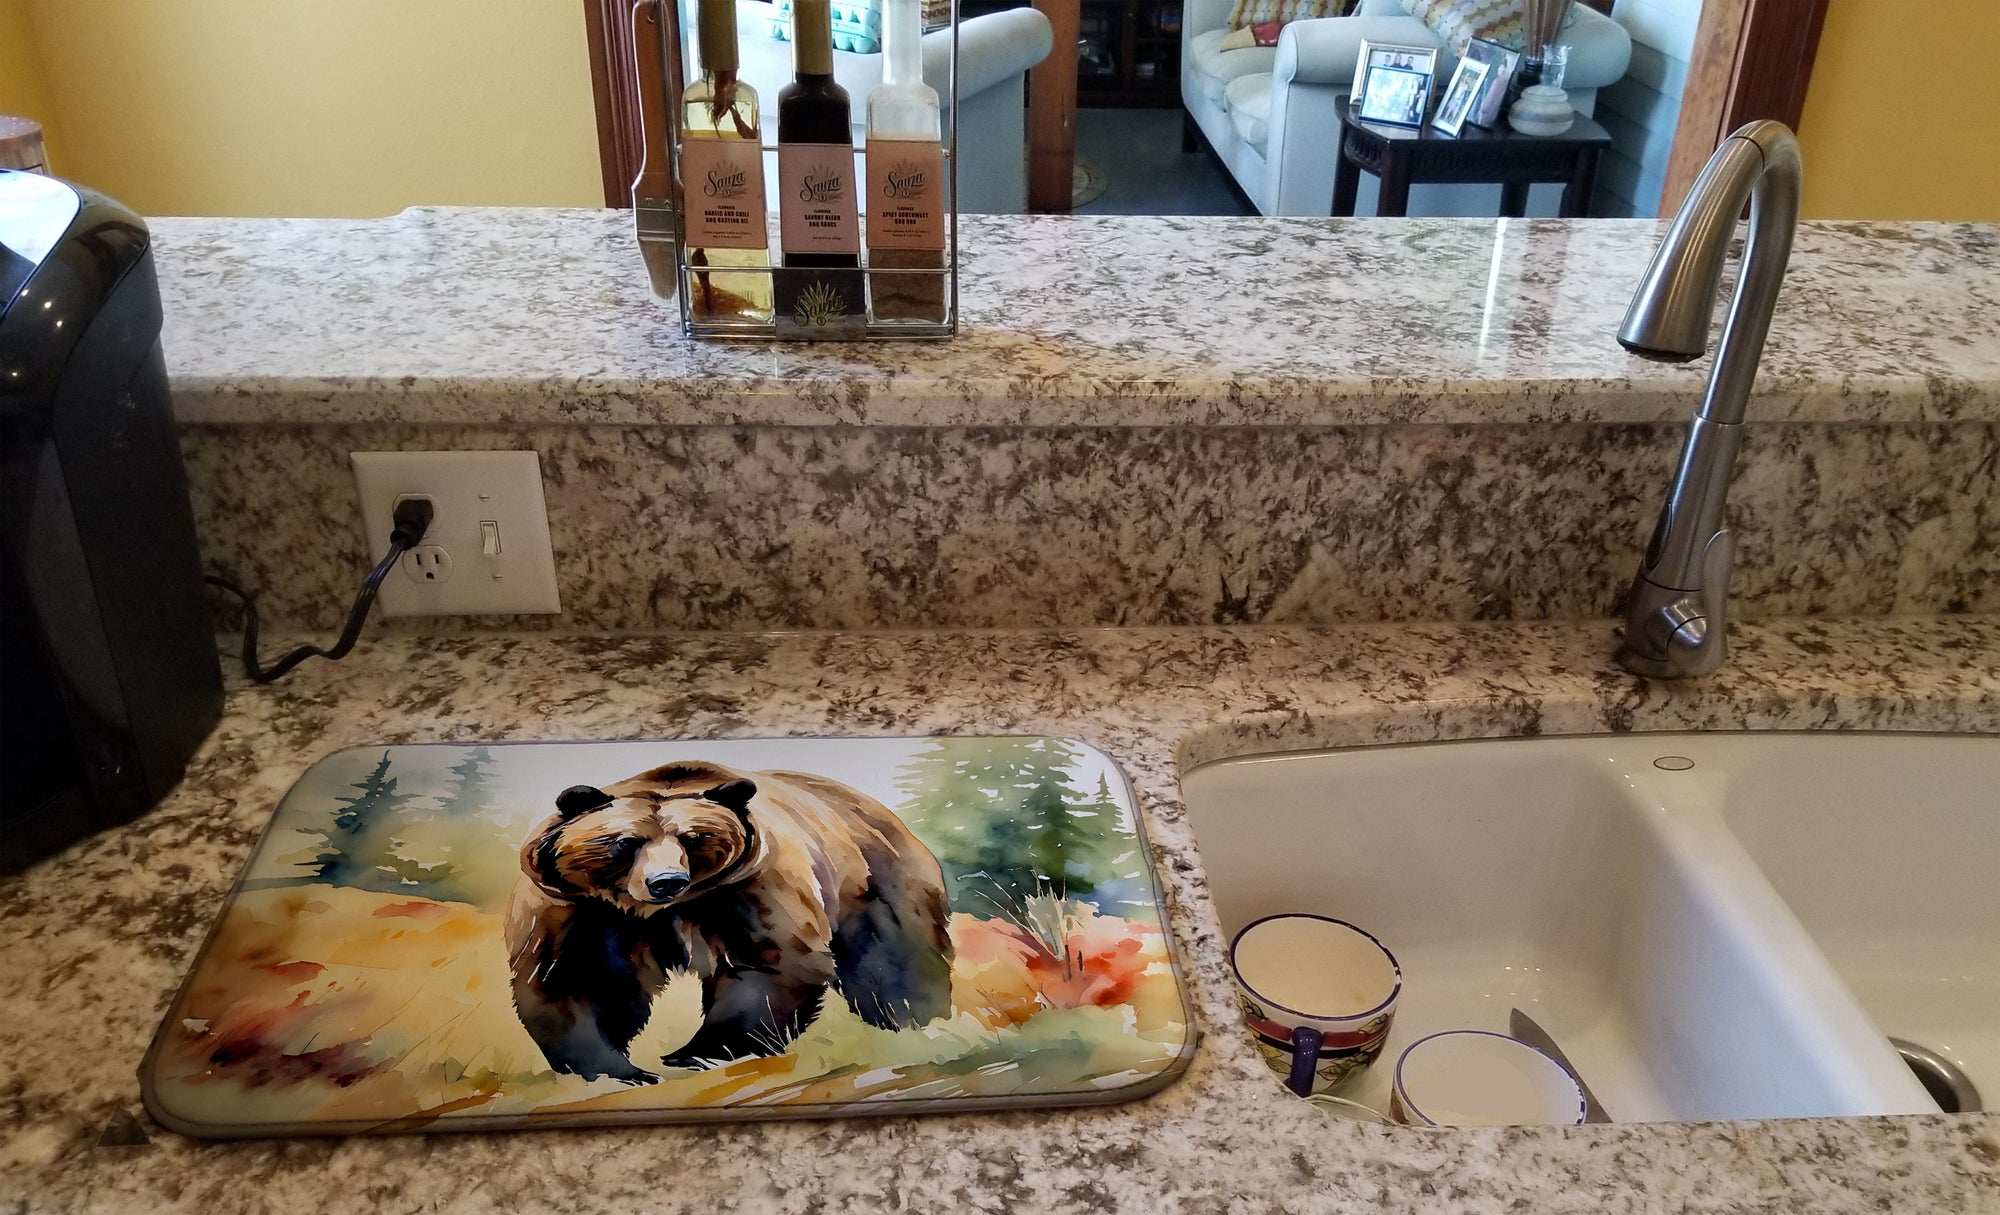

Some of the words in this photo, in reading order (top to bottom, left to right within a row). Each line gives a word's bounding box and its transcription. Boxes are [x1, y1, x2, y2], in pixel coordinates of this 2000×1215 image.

[704, 170, 745, 197] Sauza
[800, 175, 842, 202] Sauza
[884, 171, 925, 198] Sauza
[793, 295, 843, 327] Sauza
